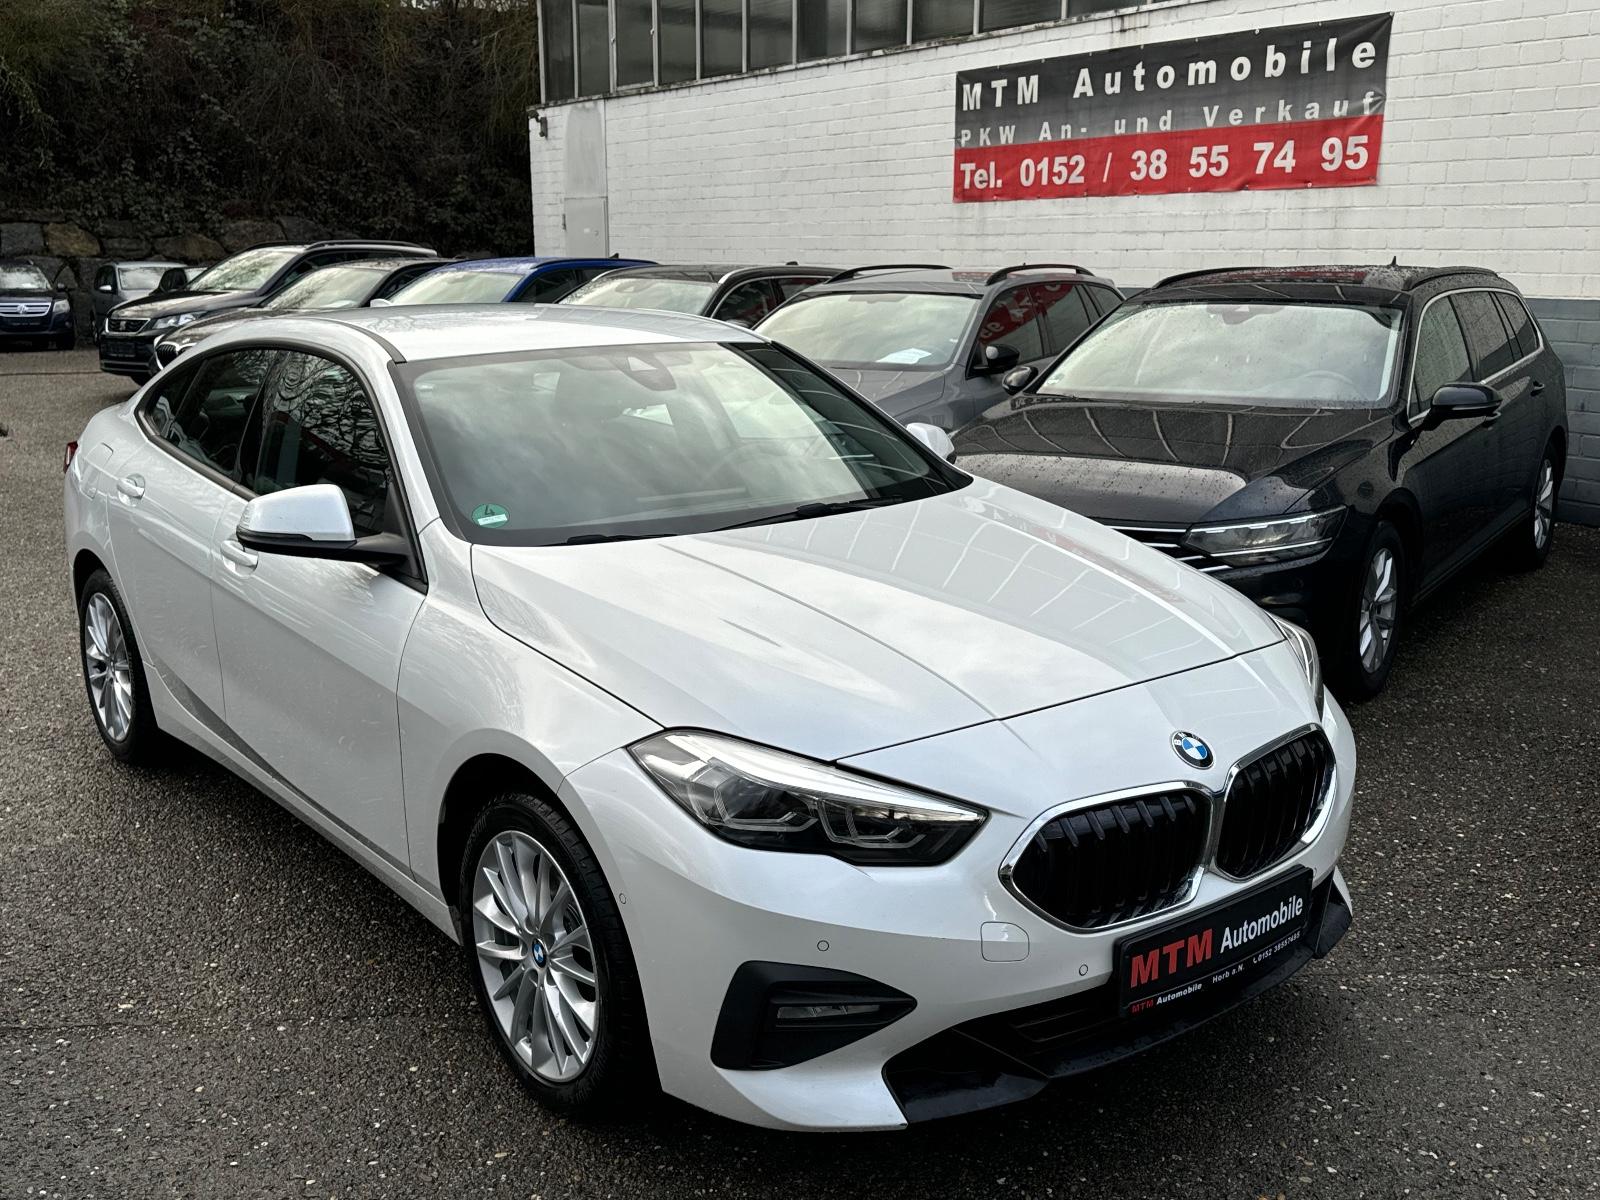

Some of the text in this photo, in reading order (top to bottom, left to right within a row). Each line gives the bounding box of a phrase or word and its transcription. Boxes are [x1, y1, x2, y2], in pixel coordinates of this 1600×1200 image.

[962, 37, 1376, 111] MTM Automobile
[960, 91, 1374, 148] PKW An- und Verkauf
[959, 135, 1369, 190] Tel. 0152 / 38 55 74 95
[1130, 895, 1303, 988] MTM Automobile
[1131, 1000, 1154, 1014] MTM
[1156, 983, 1203, 1005] Automobile
[1212, 970, 1230, 984] Horb
